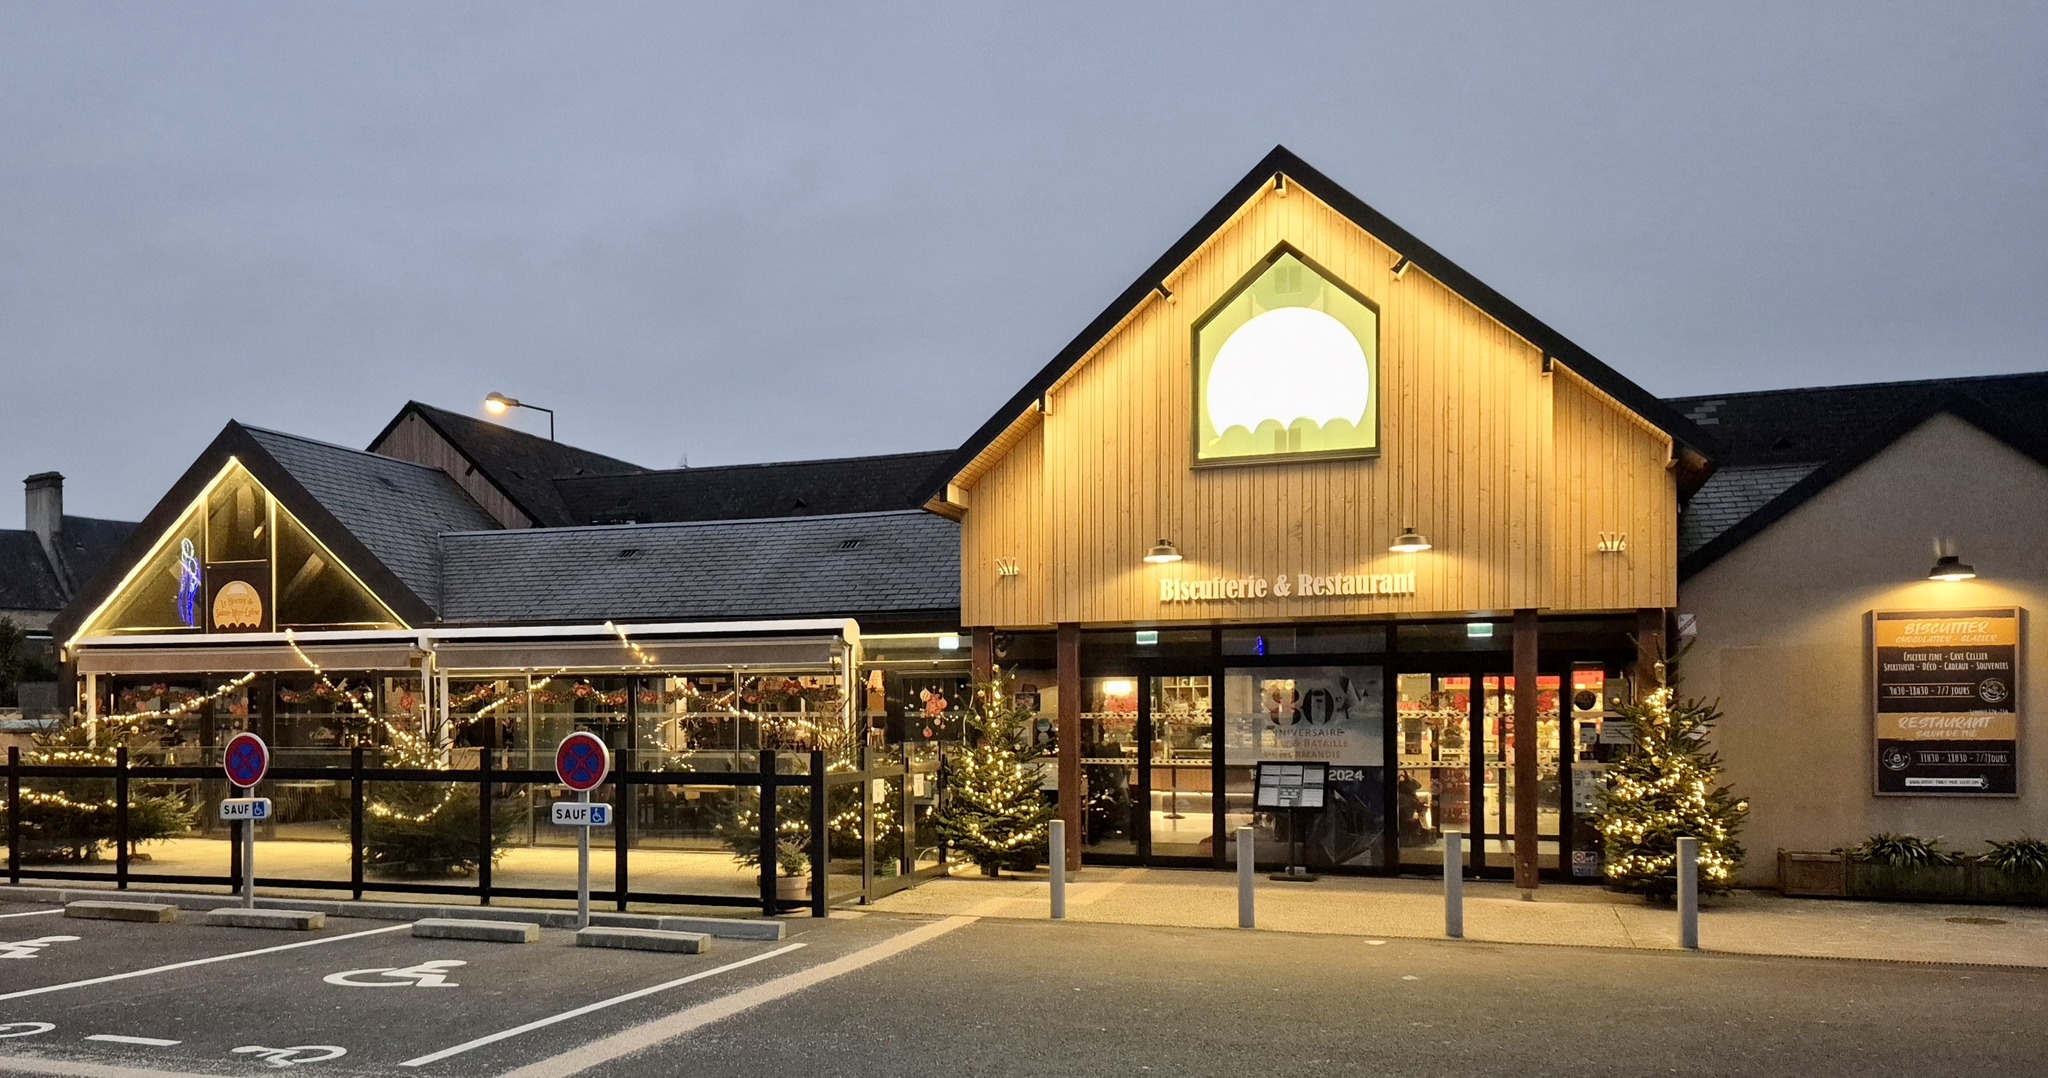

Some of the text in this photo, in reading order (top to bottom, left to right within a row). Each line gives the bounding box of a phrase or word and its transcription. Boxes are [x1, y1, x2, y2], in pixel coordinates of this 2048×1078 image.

[1159, 569, 1417, 601] Biscuiterie & Restaurant
[1904, 621, 1990, 635] BISCUITIER
[1895, 635, 1952, 644] CHOCOLATIER
[1960, 634, 1998, 642] GLACIER
[1937, 686, 1949, 695] 7/7
[1898, 716, 1995, 729] RESTAURANT
[1328, 769, 1364, 782] 2024
[224, 804, 250, 816] SAUF
[556, 807, 587, 821] SAUF
